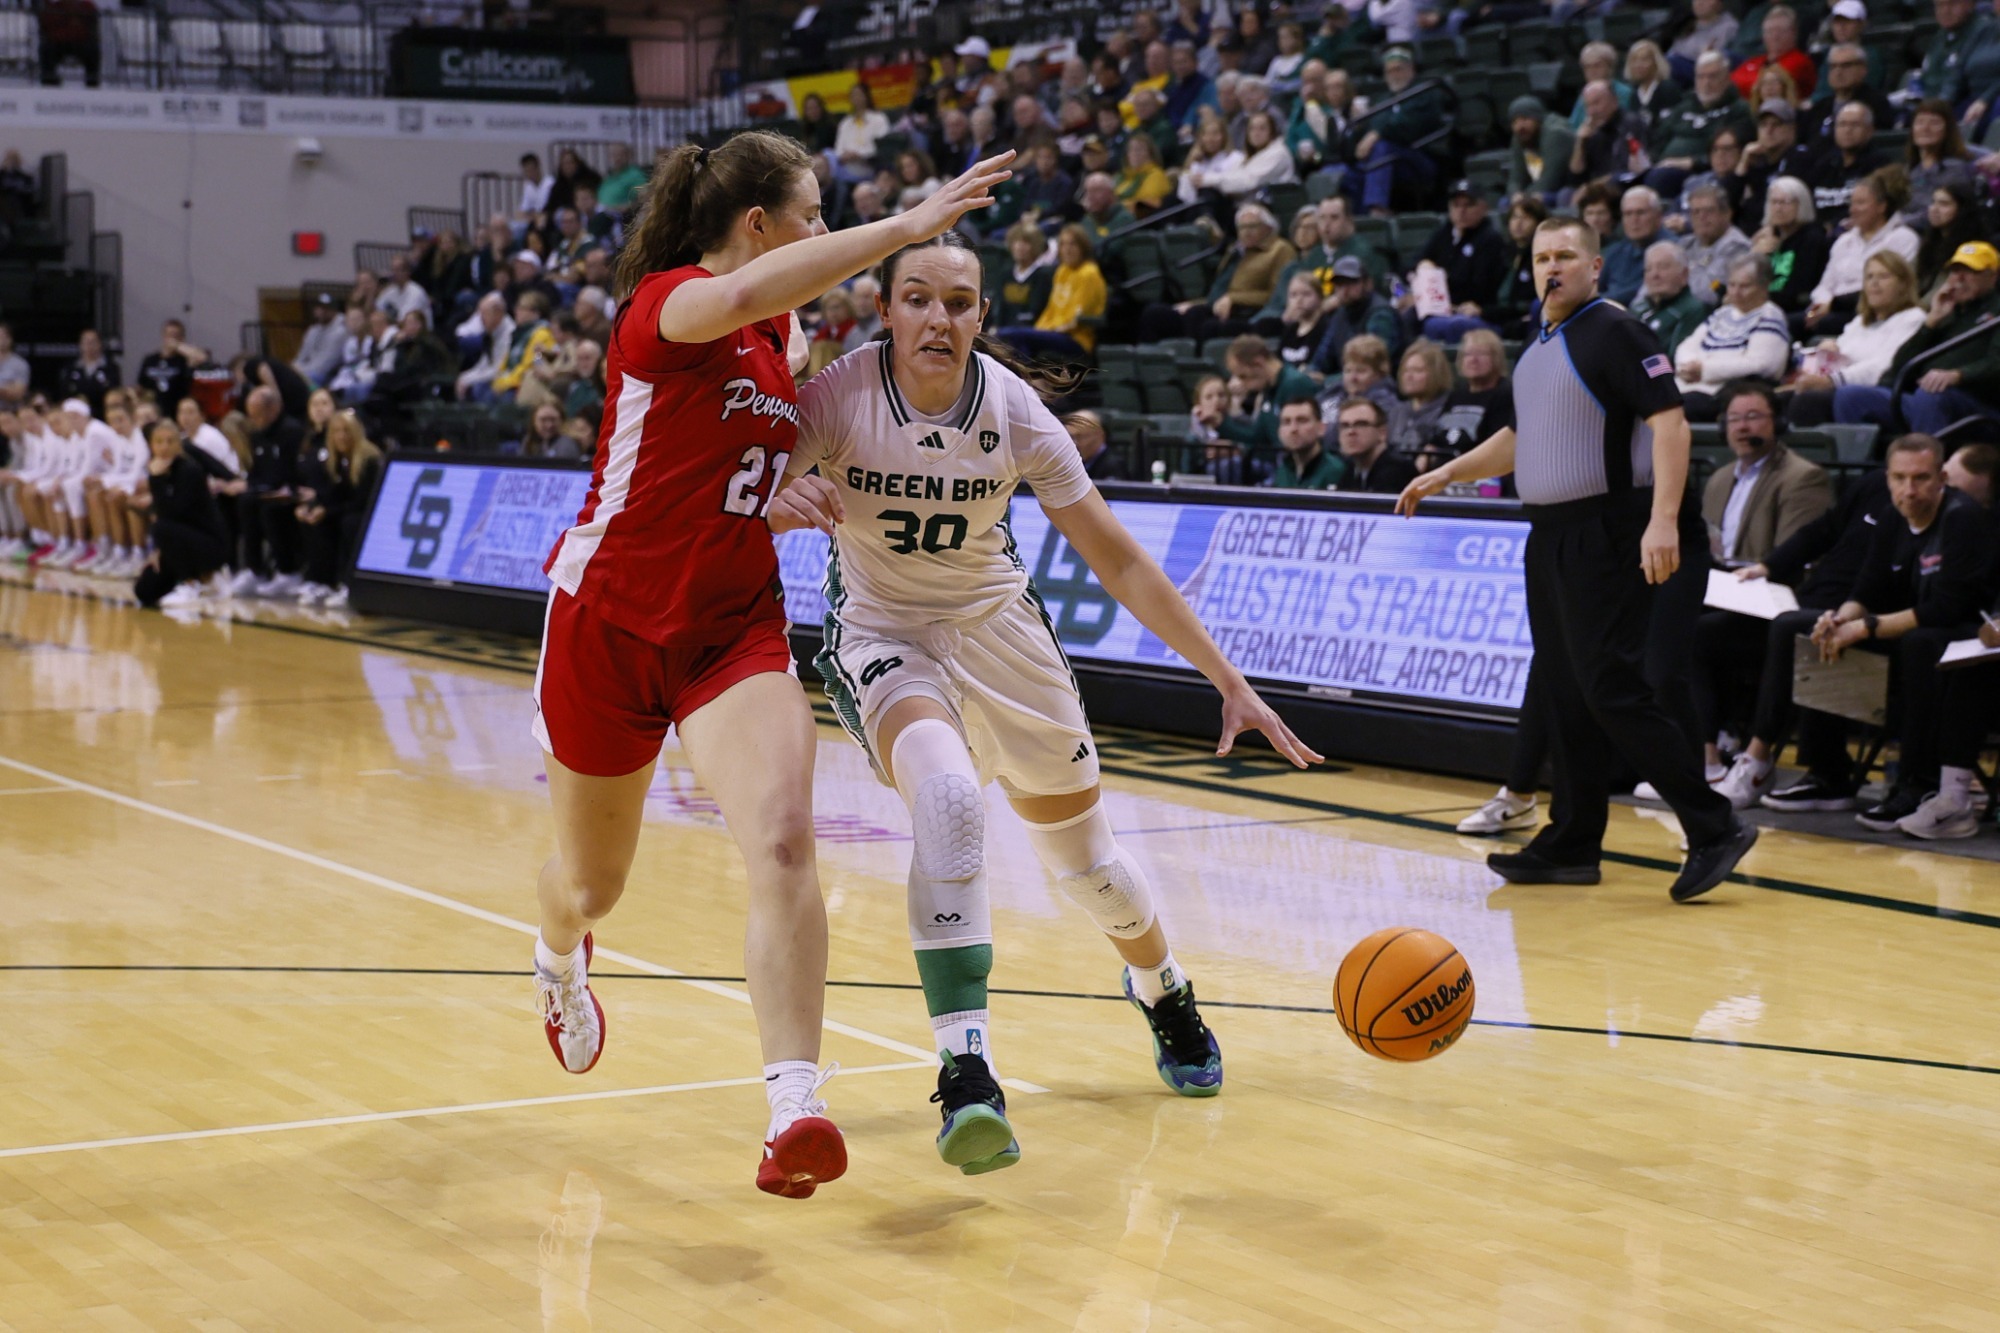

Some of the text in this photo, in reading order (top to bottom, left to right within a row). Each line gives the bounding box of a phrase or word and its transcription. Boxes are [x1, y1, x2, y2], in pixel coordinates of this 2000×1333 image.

[721, 378, 799, 428] Pengui
[724, 446, 790, 518] 21
[847, 466, 1005, 501] GREEN BAY
[876, 509, 968, 554] 30
[1222, 511, 1377, 565] GREEN BAY
[1199, 562, 1336, 630] AUSTIN
[1205, 624, 1527, 700] TERNATIONAL AIRPORT
[1401, 967, 1473, 1027] Wilson
